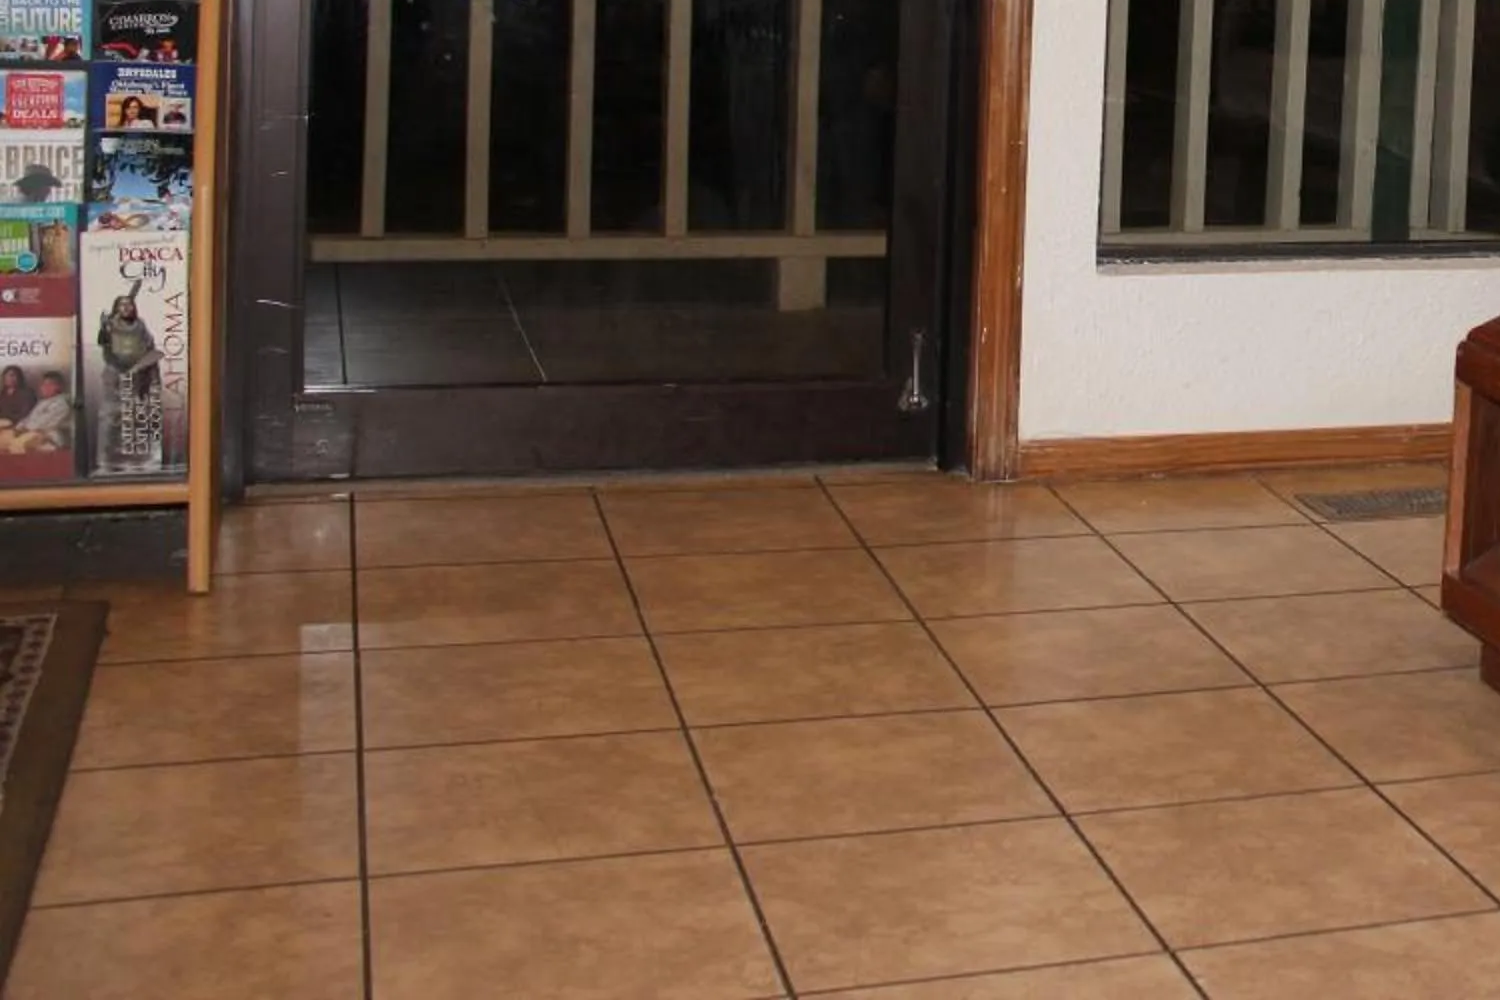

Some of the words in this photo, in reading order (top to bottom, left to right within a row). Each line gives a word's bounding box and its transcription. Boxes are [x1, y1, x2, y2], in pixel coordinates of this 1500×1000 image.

[11, 7, 82, 32] FUTURE
[119, 246, 184, 262] PONCA
[119, 261, 168, 293] City
[0, 341, 53, 358] EGACY
